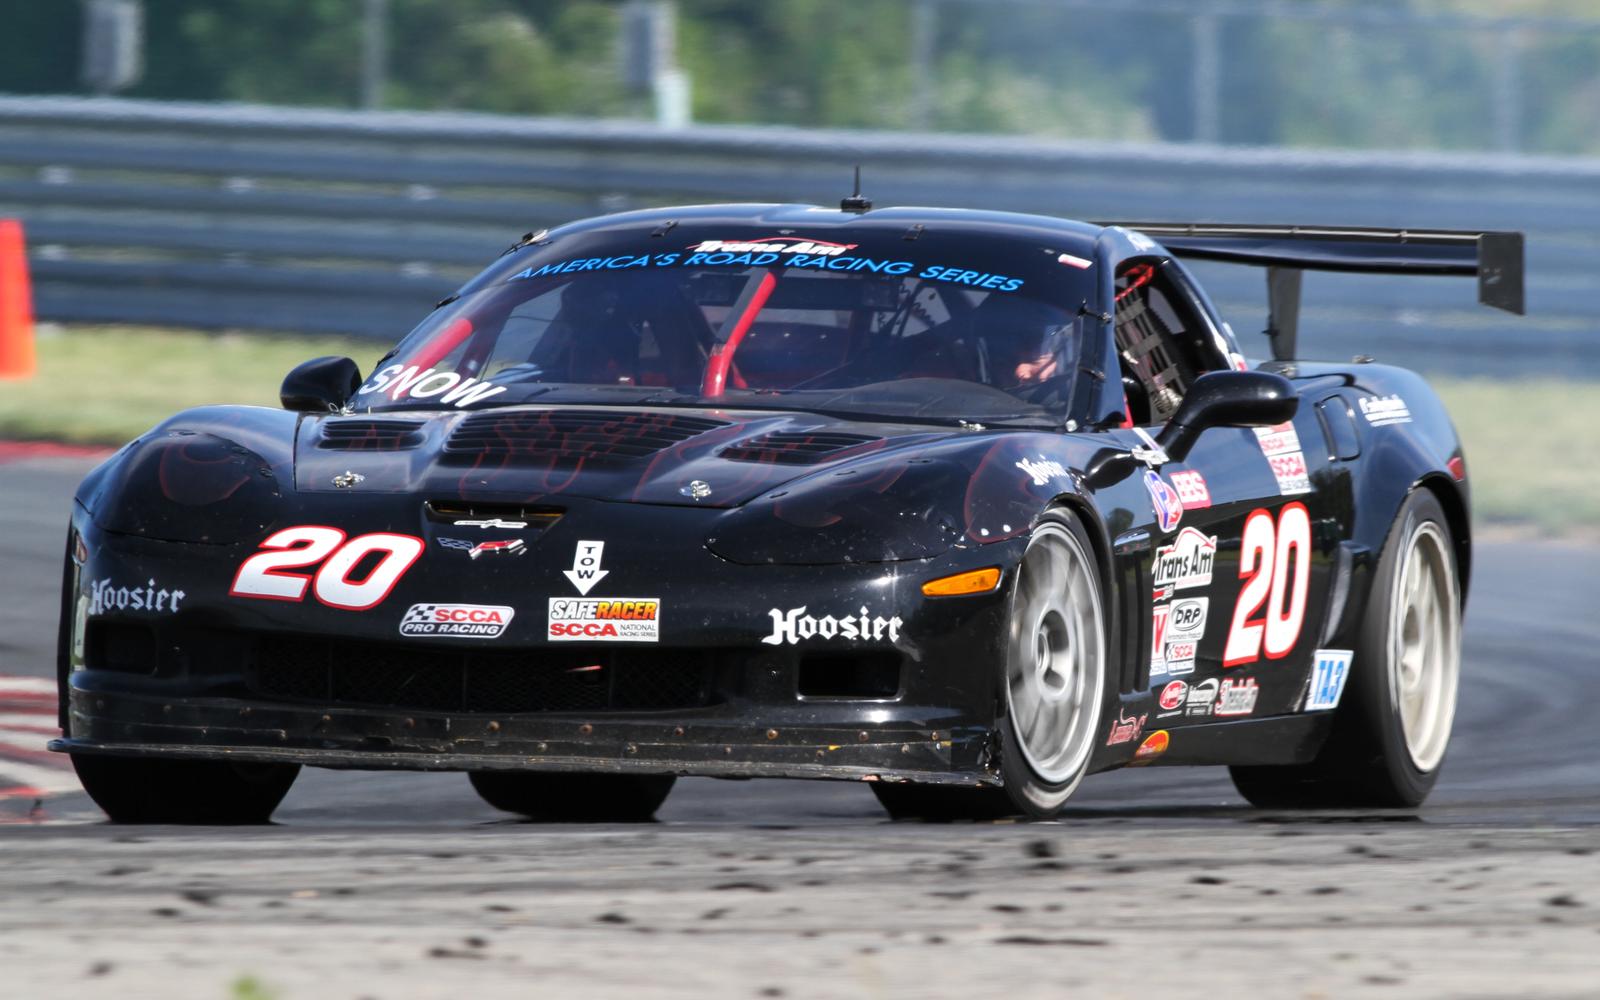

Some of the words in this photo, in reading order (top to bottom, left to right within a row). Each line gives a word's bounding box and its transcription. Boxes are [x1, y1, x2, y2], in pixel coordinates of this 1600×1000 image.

[694, 240, 787, 252] Trans
[781, 242, 847, 256] Am
[508, 253, 680, 281] AMERICA'S
[684, 253, 779, 266] ROAD
[785, 255, 914, 276] RACING
[920, 265, 1024, 293] SERIES
[359, 364, 507, 407] SNOW
[228, 525, 426, 611] 20
[576, 546, 596, 579] TOW
[1155, 551, 1188, 581] Trans
[1190, 544, 1212, 575] Am
[88, 578, 185, 615] Hoosier
[1223, 502, 1311, 668] 20
[434, 609, 502, 624] SCCA
[551, 600, 657, 620] SAFERACER
[761, 605, 903, 645] Hoosier
[1175, 608, 1201, 625] DRP
[403, 623, 435, 633] PRO
[437, 624, 499, 635] RACING
[550, 623, 618, 636] SCCA
[1313, 660, 1344, 704] TA3
